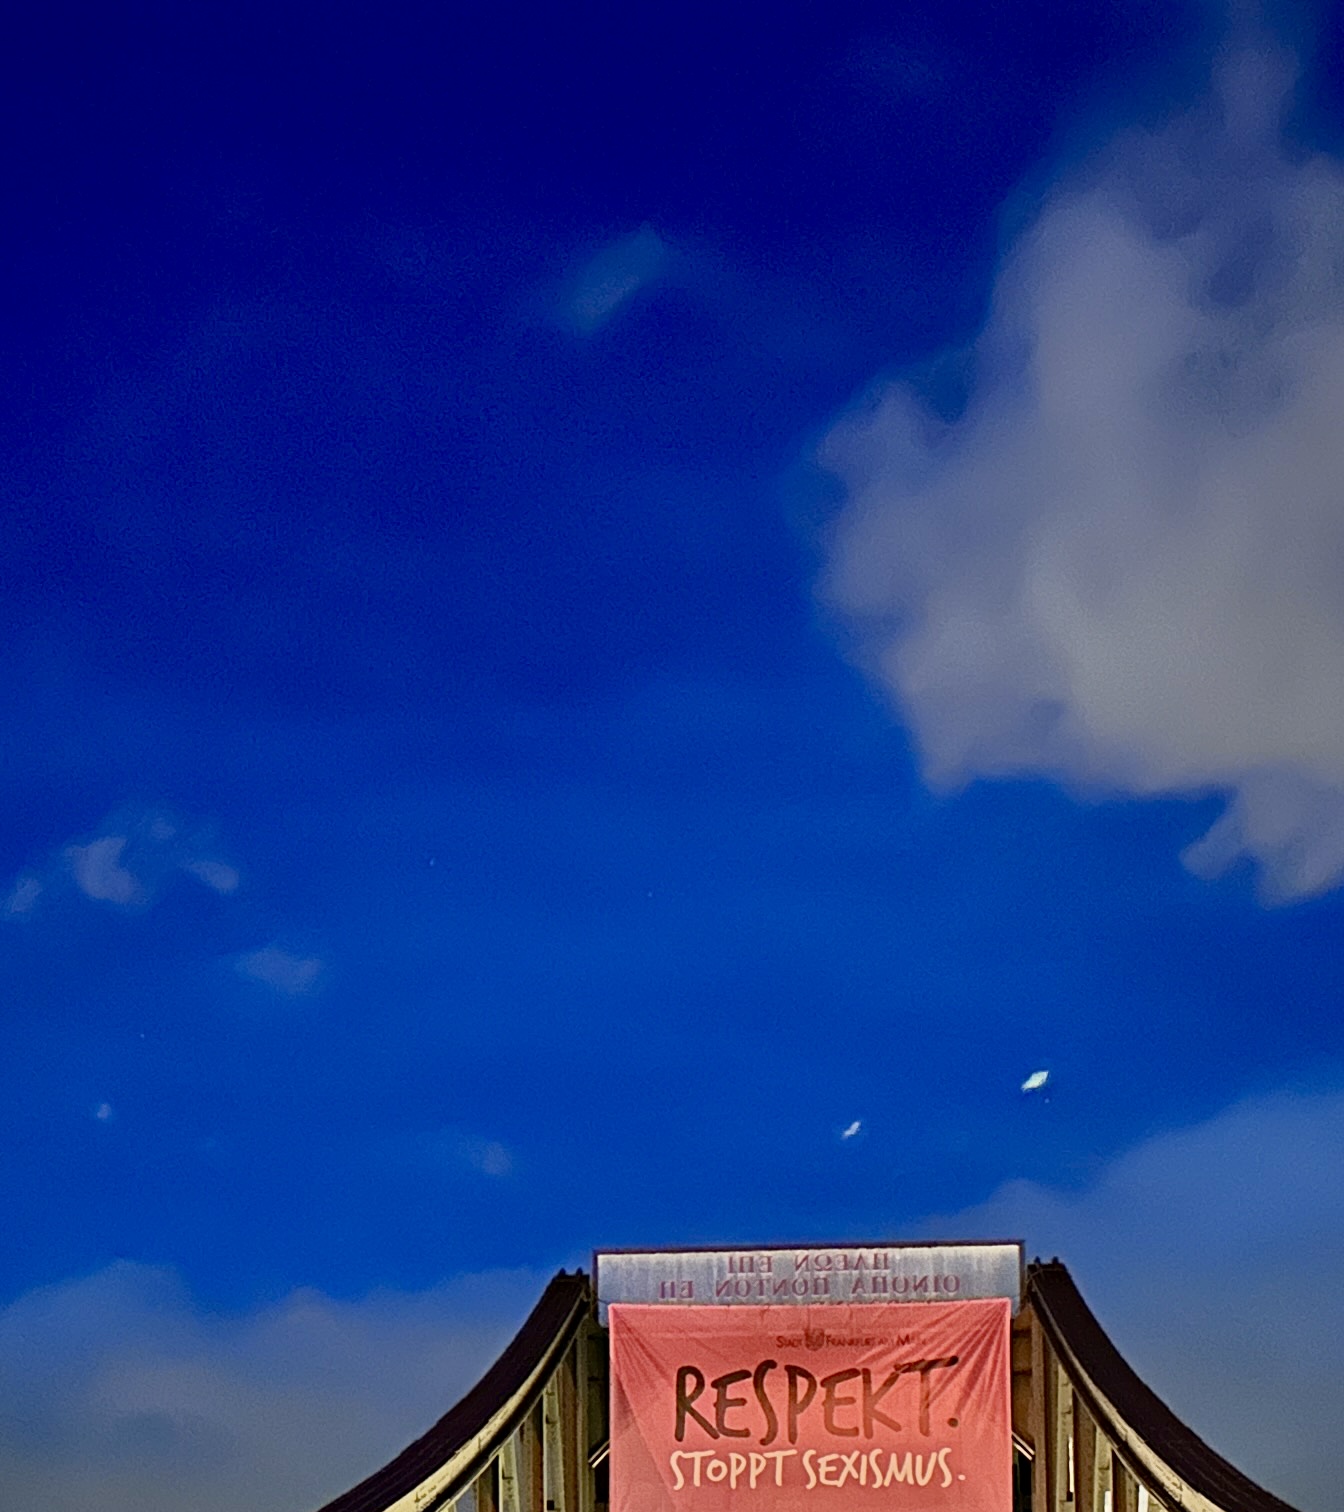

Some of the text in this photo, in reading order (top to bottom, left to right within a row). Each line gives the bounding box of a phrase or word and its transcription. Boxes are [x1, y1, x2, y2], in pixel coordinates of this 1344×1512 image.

[673, 1355, 959, 1446] RESPEKT.
[670, 1447, 966, 1491] STOPPT SEXISMUS.
